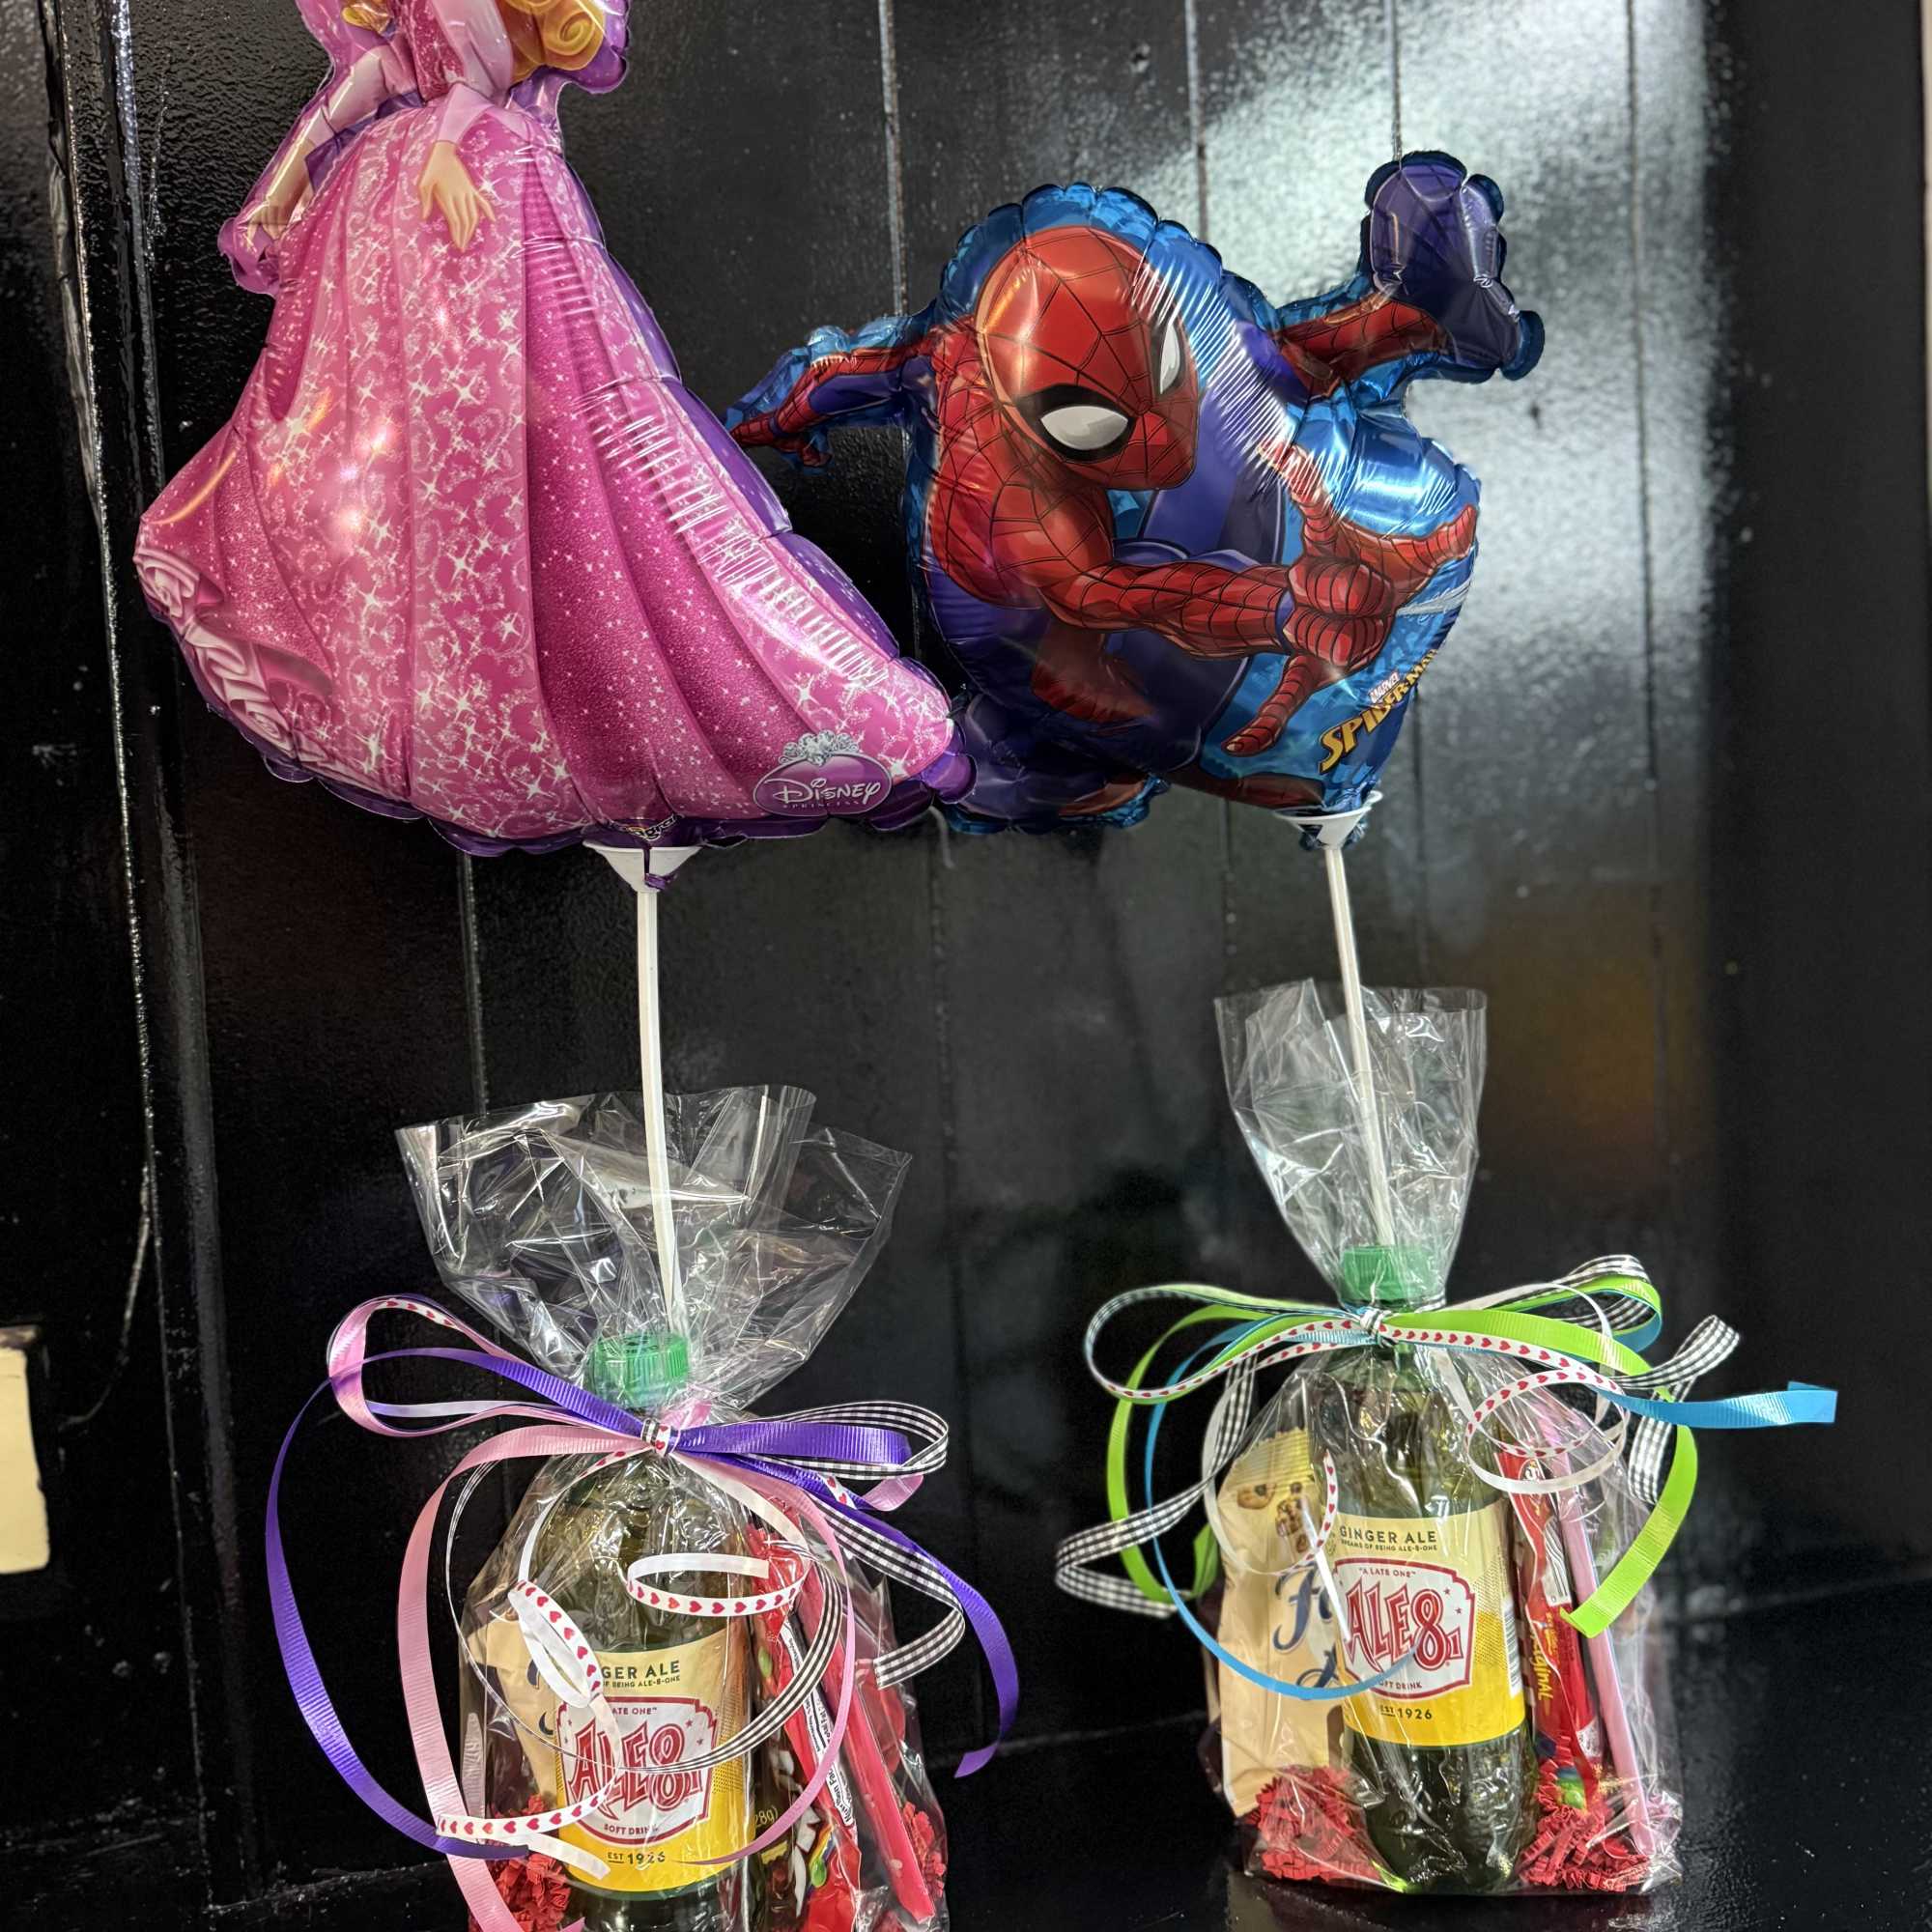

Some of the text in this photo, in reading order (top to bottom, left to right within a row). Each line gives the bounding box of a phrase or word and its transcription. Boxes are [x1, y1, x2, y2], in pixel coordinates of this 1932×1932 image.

[1339, 1525, 1437, 1544] GINGER ALE
[645, 1660, 680, 1678] ALE
[1396, 1682, 1422, 1690] DRINK
[611, 1707, 629, 1716] ATE
[1398, 1708, 1433, 1719] 1926
[604, 1824, 626, 1834] SOFT
[608, 1851, 666, 1864] EST 1926
